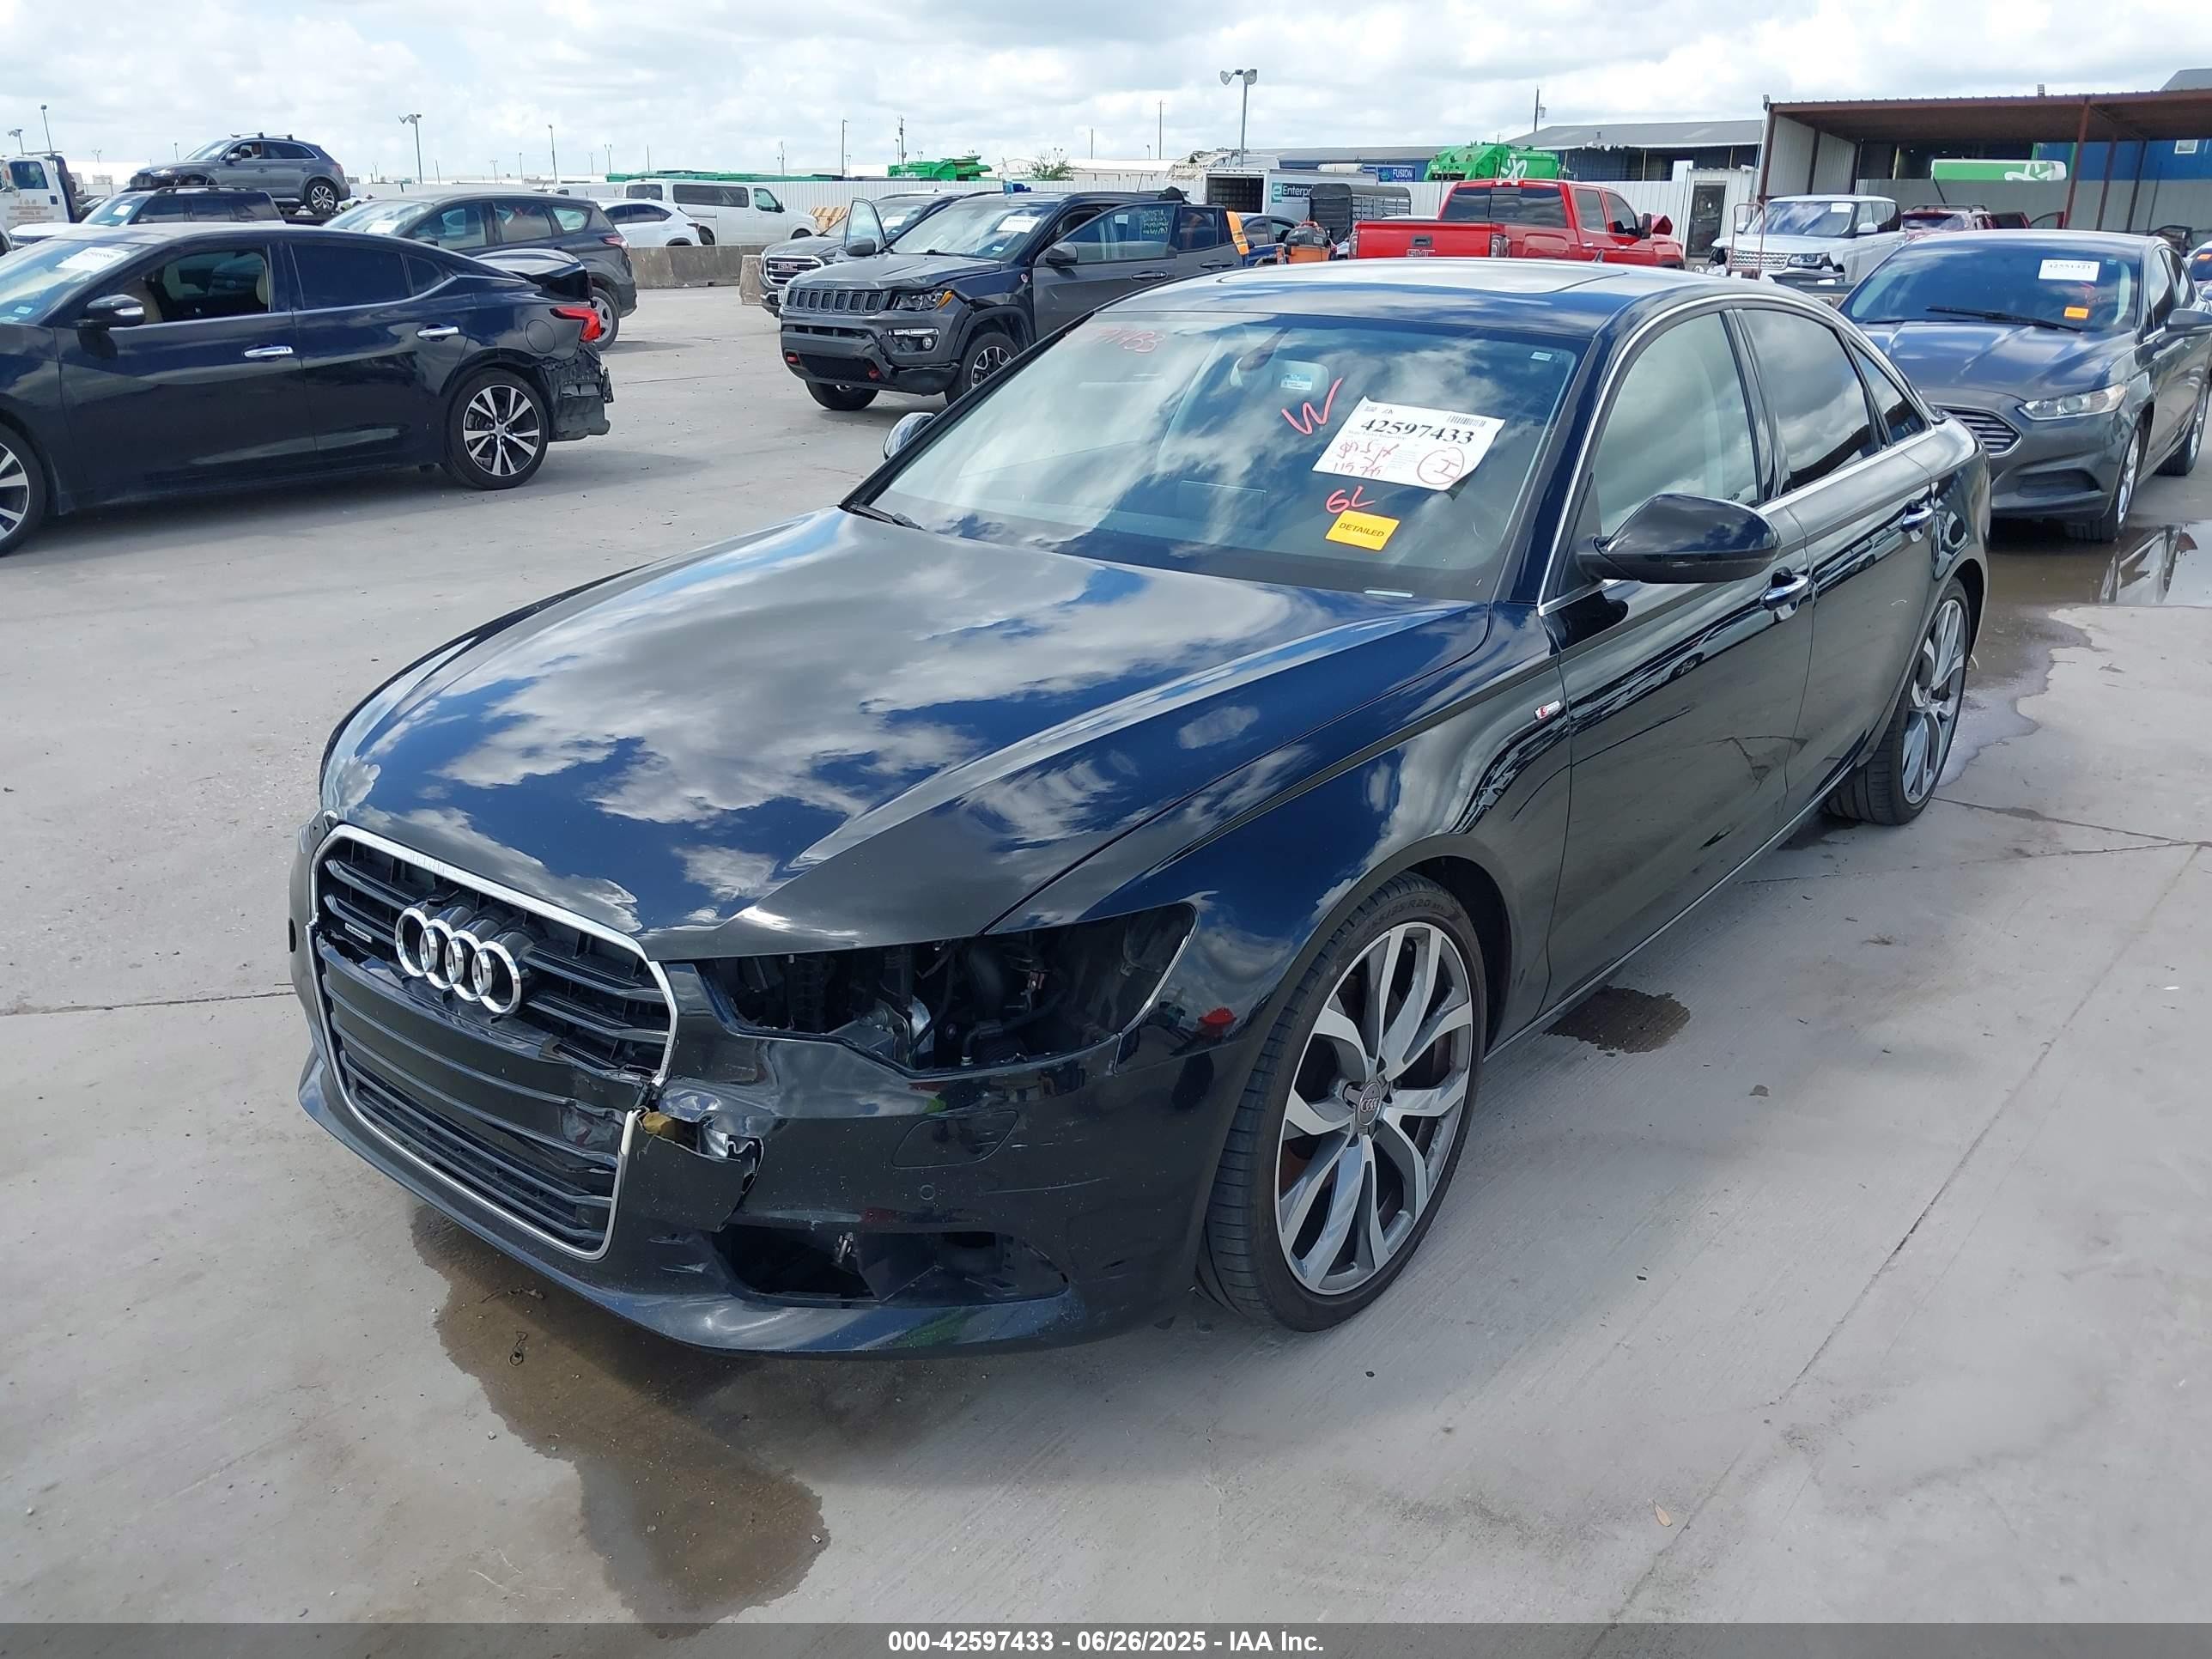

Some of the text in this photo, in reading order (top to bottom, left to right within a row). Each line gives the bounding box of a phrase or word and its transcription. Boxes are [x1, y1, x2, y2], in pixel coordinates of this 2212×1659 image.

[1392, 168, 1413, 179] FUSION
[1282, 185, 1314, 197] Enterpr
[777, 263, 798, 272] GMC
[1280, 378, 1343, 435] W
[1360, 418, 1475, 445] 42597433
[1339, 522, 1385, 538] DETAILED
